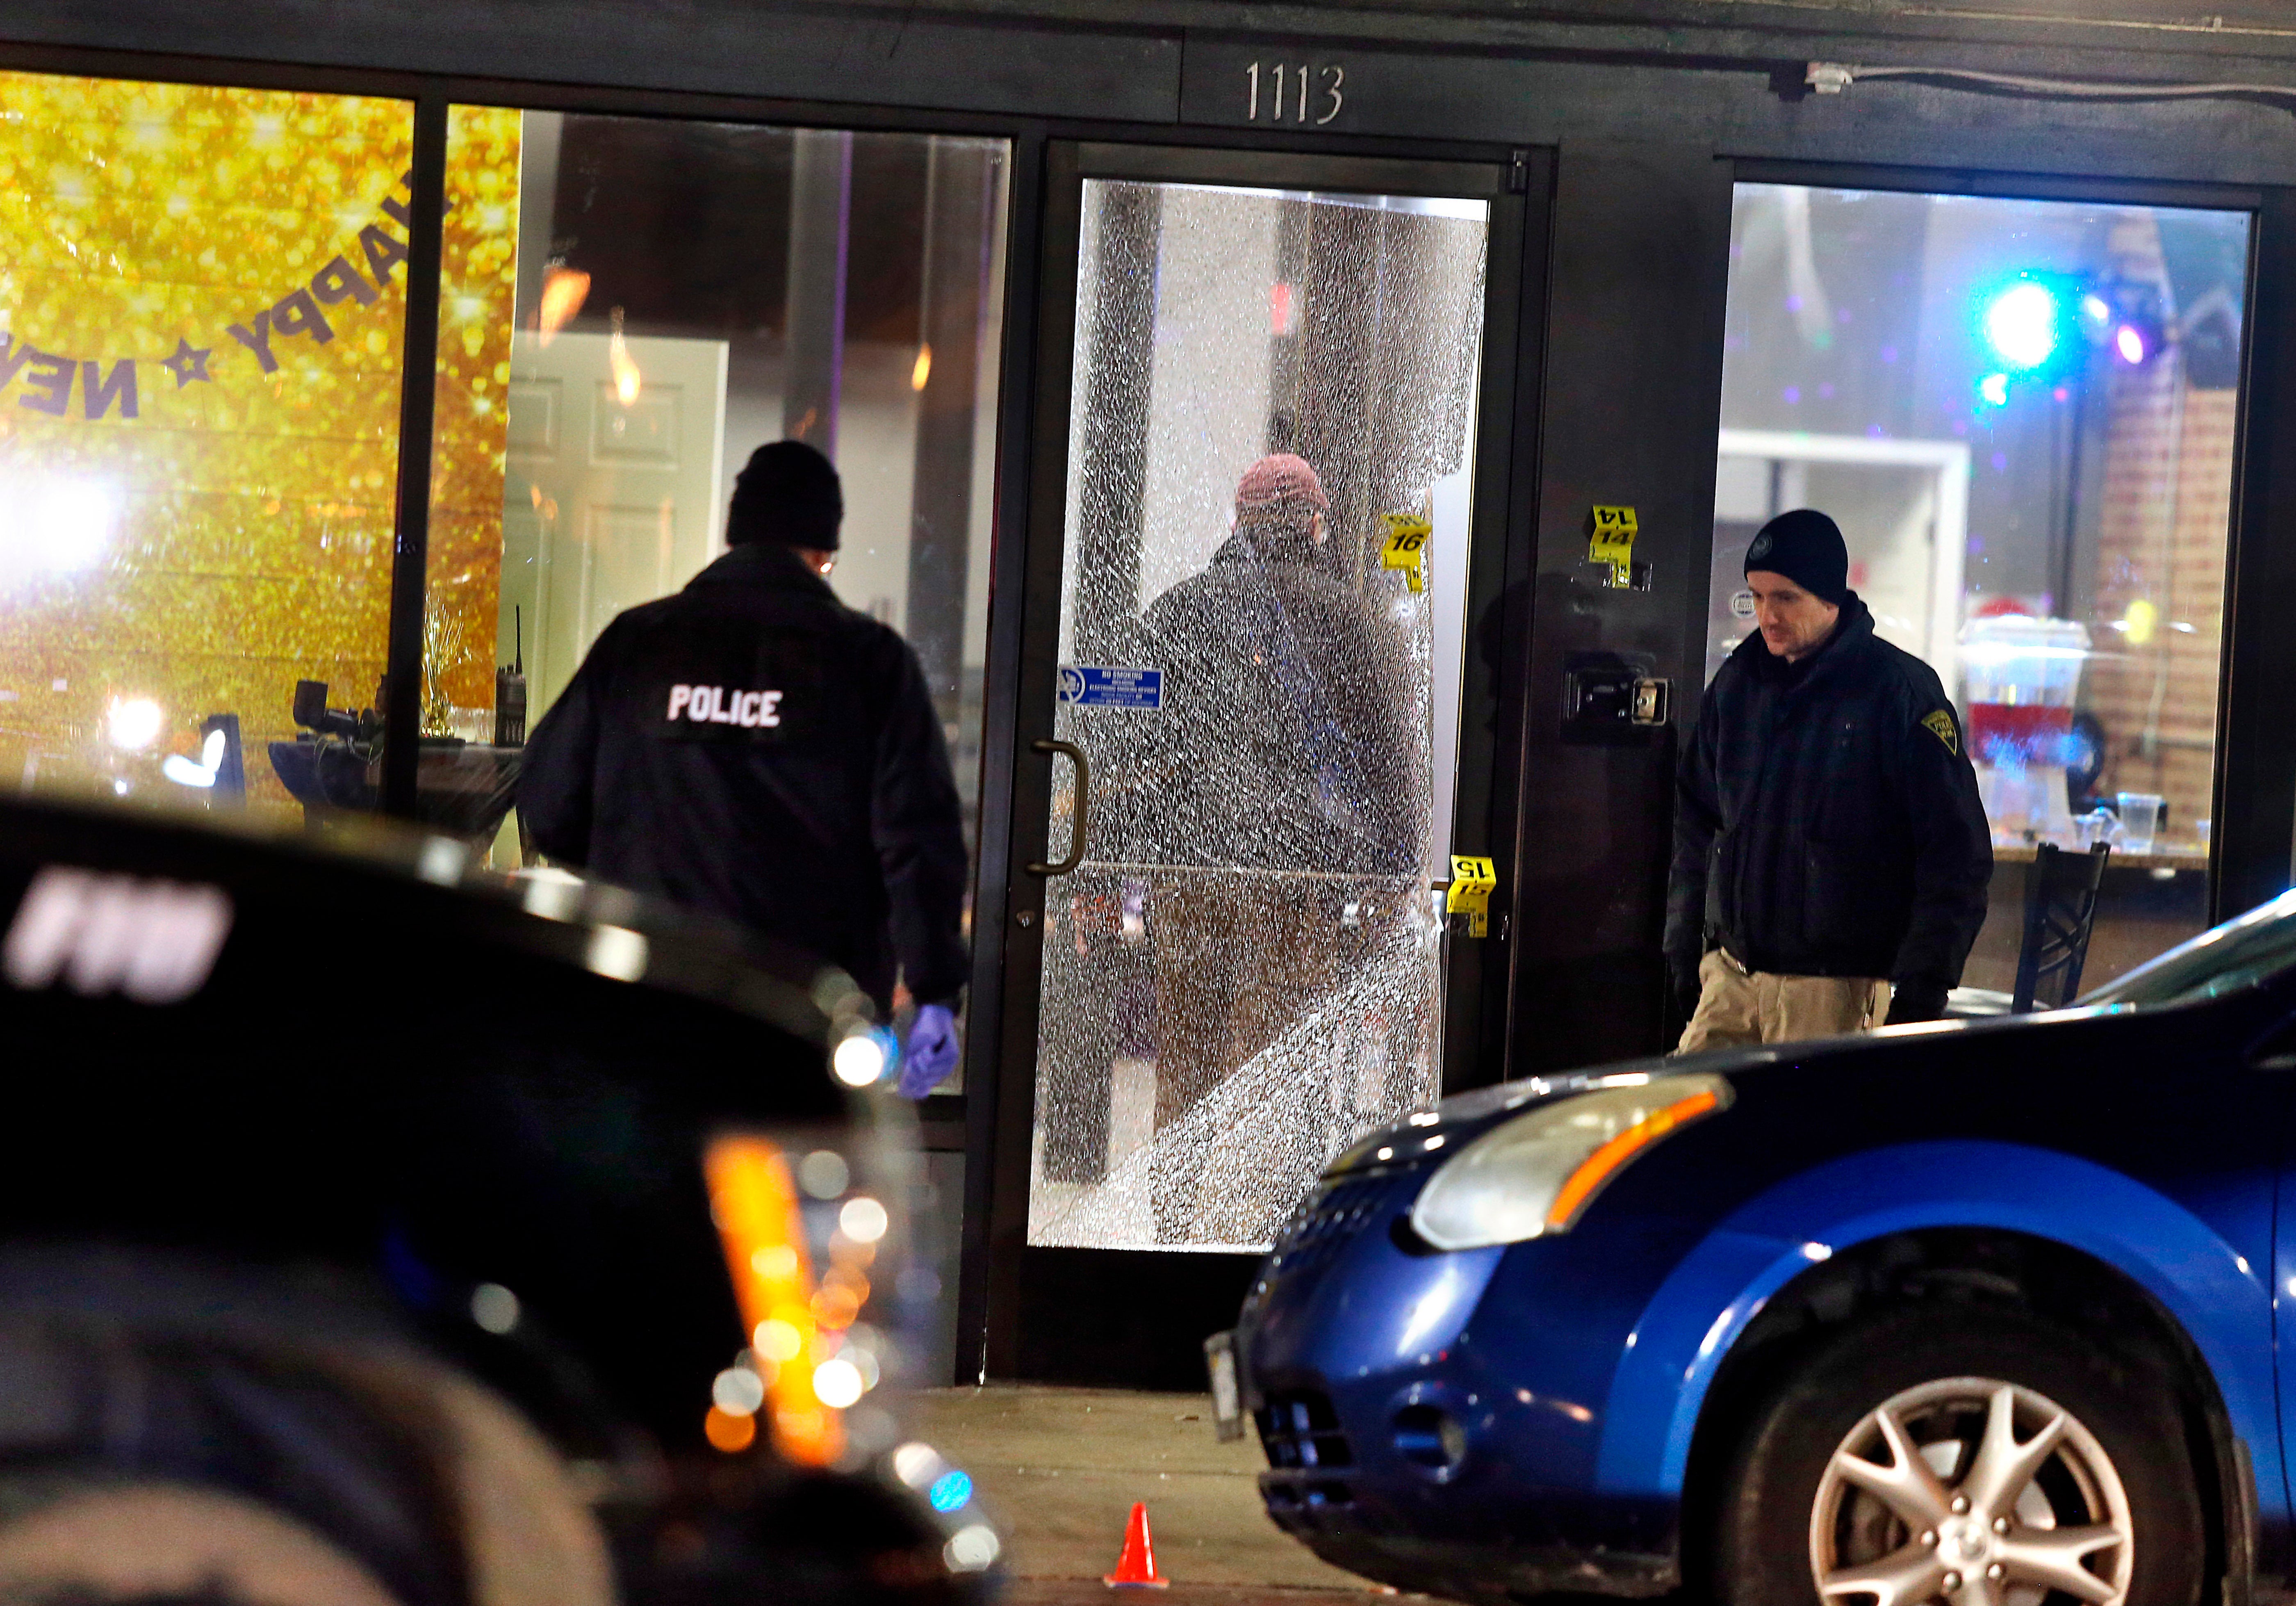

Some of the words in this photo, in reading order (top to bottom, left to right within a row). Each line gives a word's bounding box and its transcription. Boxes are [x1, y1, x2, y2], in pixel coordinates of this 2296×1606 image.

[1247, 62, 1344, 124] 1113
[1393, 534, 1424, 551] 16
[666, 683, 783, 728] POLICE
